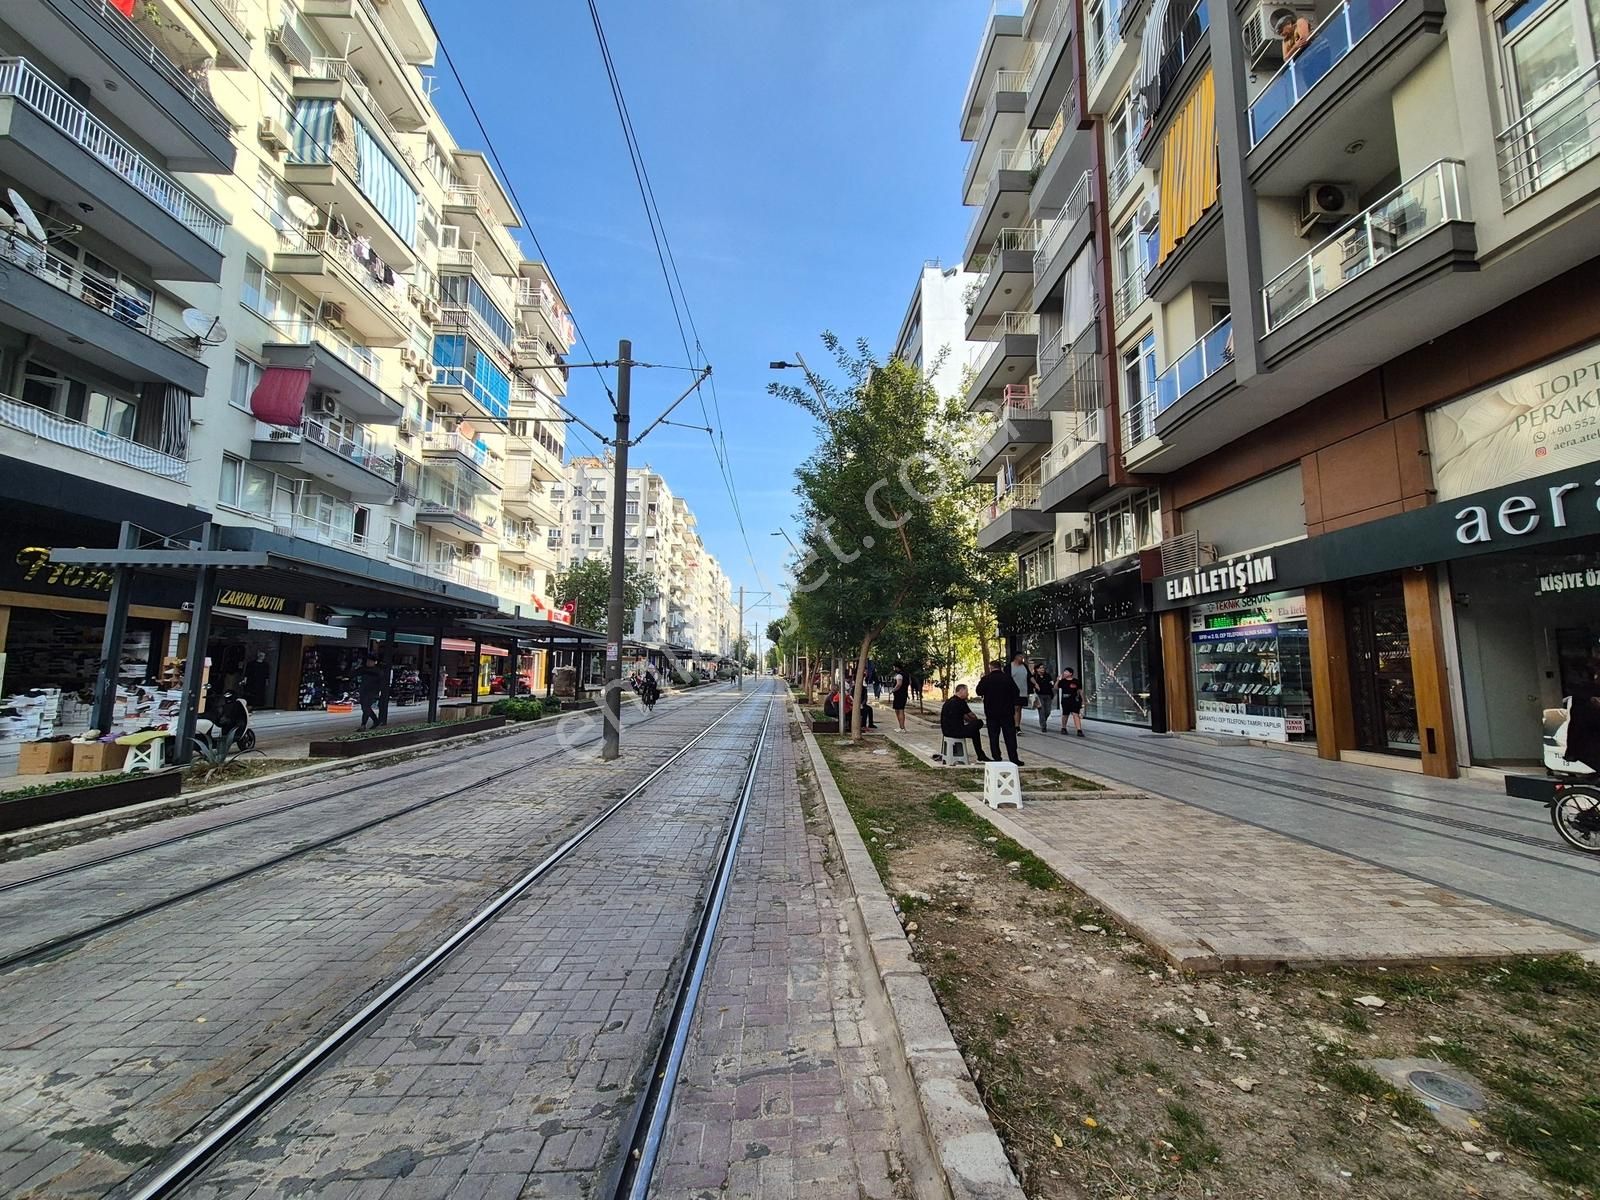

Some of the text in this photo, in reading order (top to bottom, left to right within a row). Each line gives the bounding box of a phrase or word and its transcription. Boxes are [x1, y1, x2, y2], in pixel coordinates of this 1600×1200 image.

[1535, 362, 1600, 399] TOPT
[1455, 479, 1600, 544] aer
[1166, 554, 1274, 600] ELA İLETİŞİM
[1540, 572, 1584, 592] KİŞİYE
